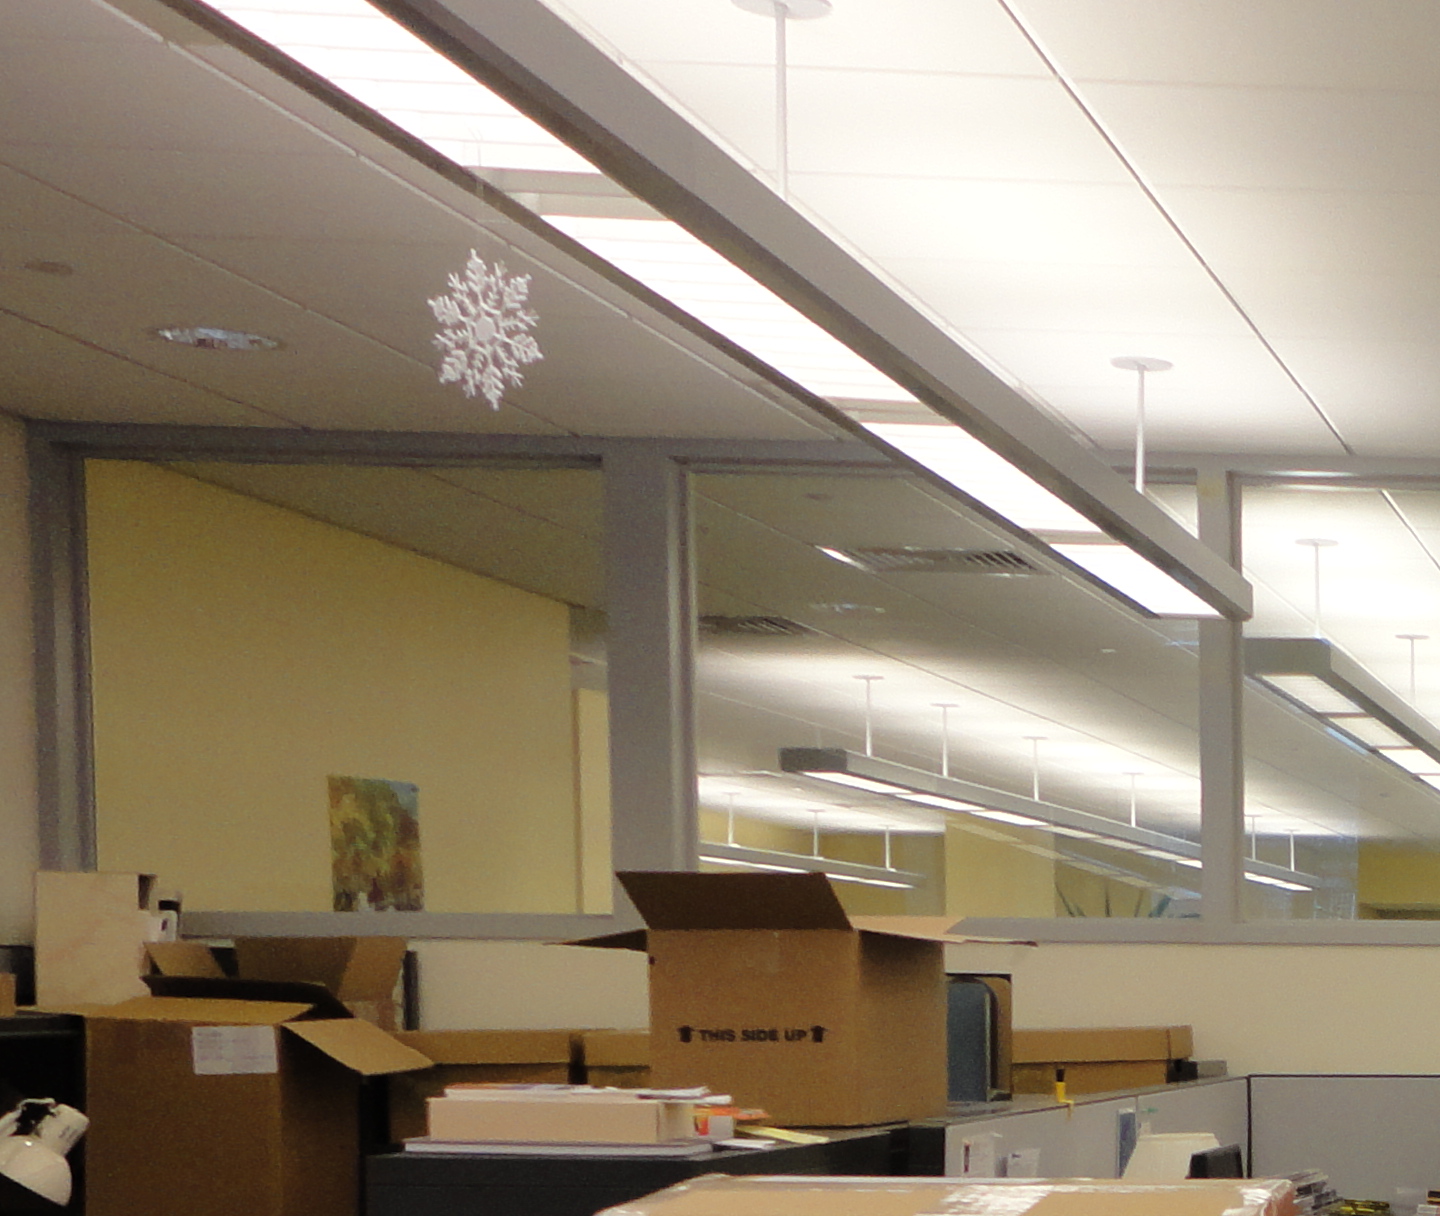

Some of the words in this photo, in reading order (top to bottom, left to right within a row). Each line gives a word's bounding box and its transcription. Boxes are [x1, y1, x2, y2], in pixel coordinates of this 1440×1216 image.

[699, 1028, 736, 1043] THIS
[740, 1028, 778, 1043] SIDE
[784, 1028, 807, 1042] UP
